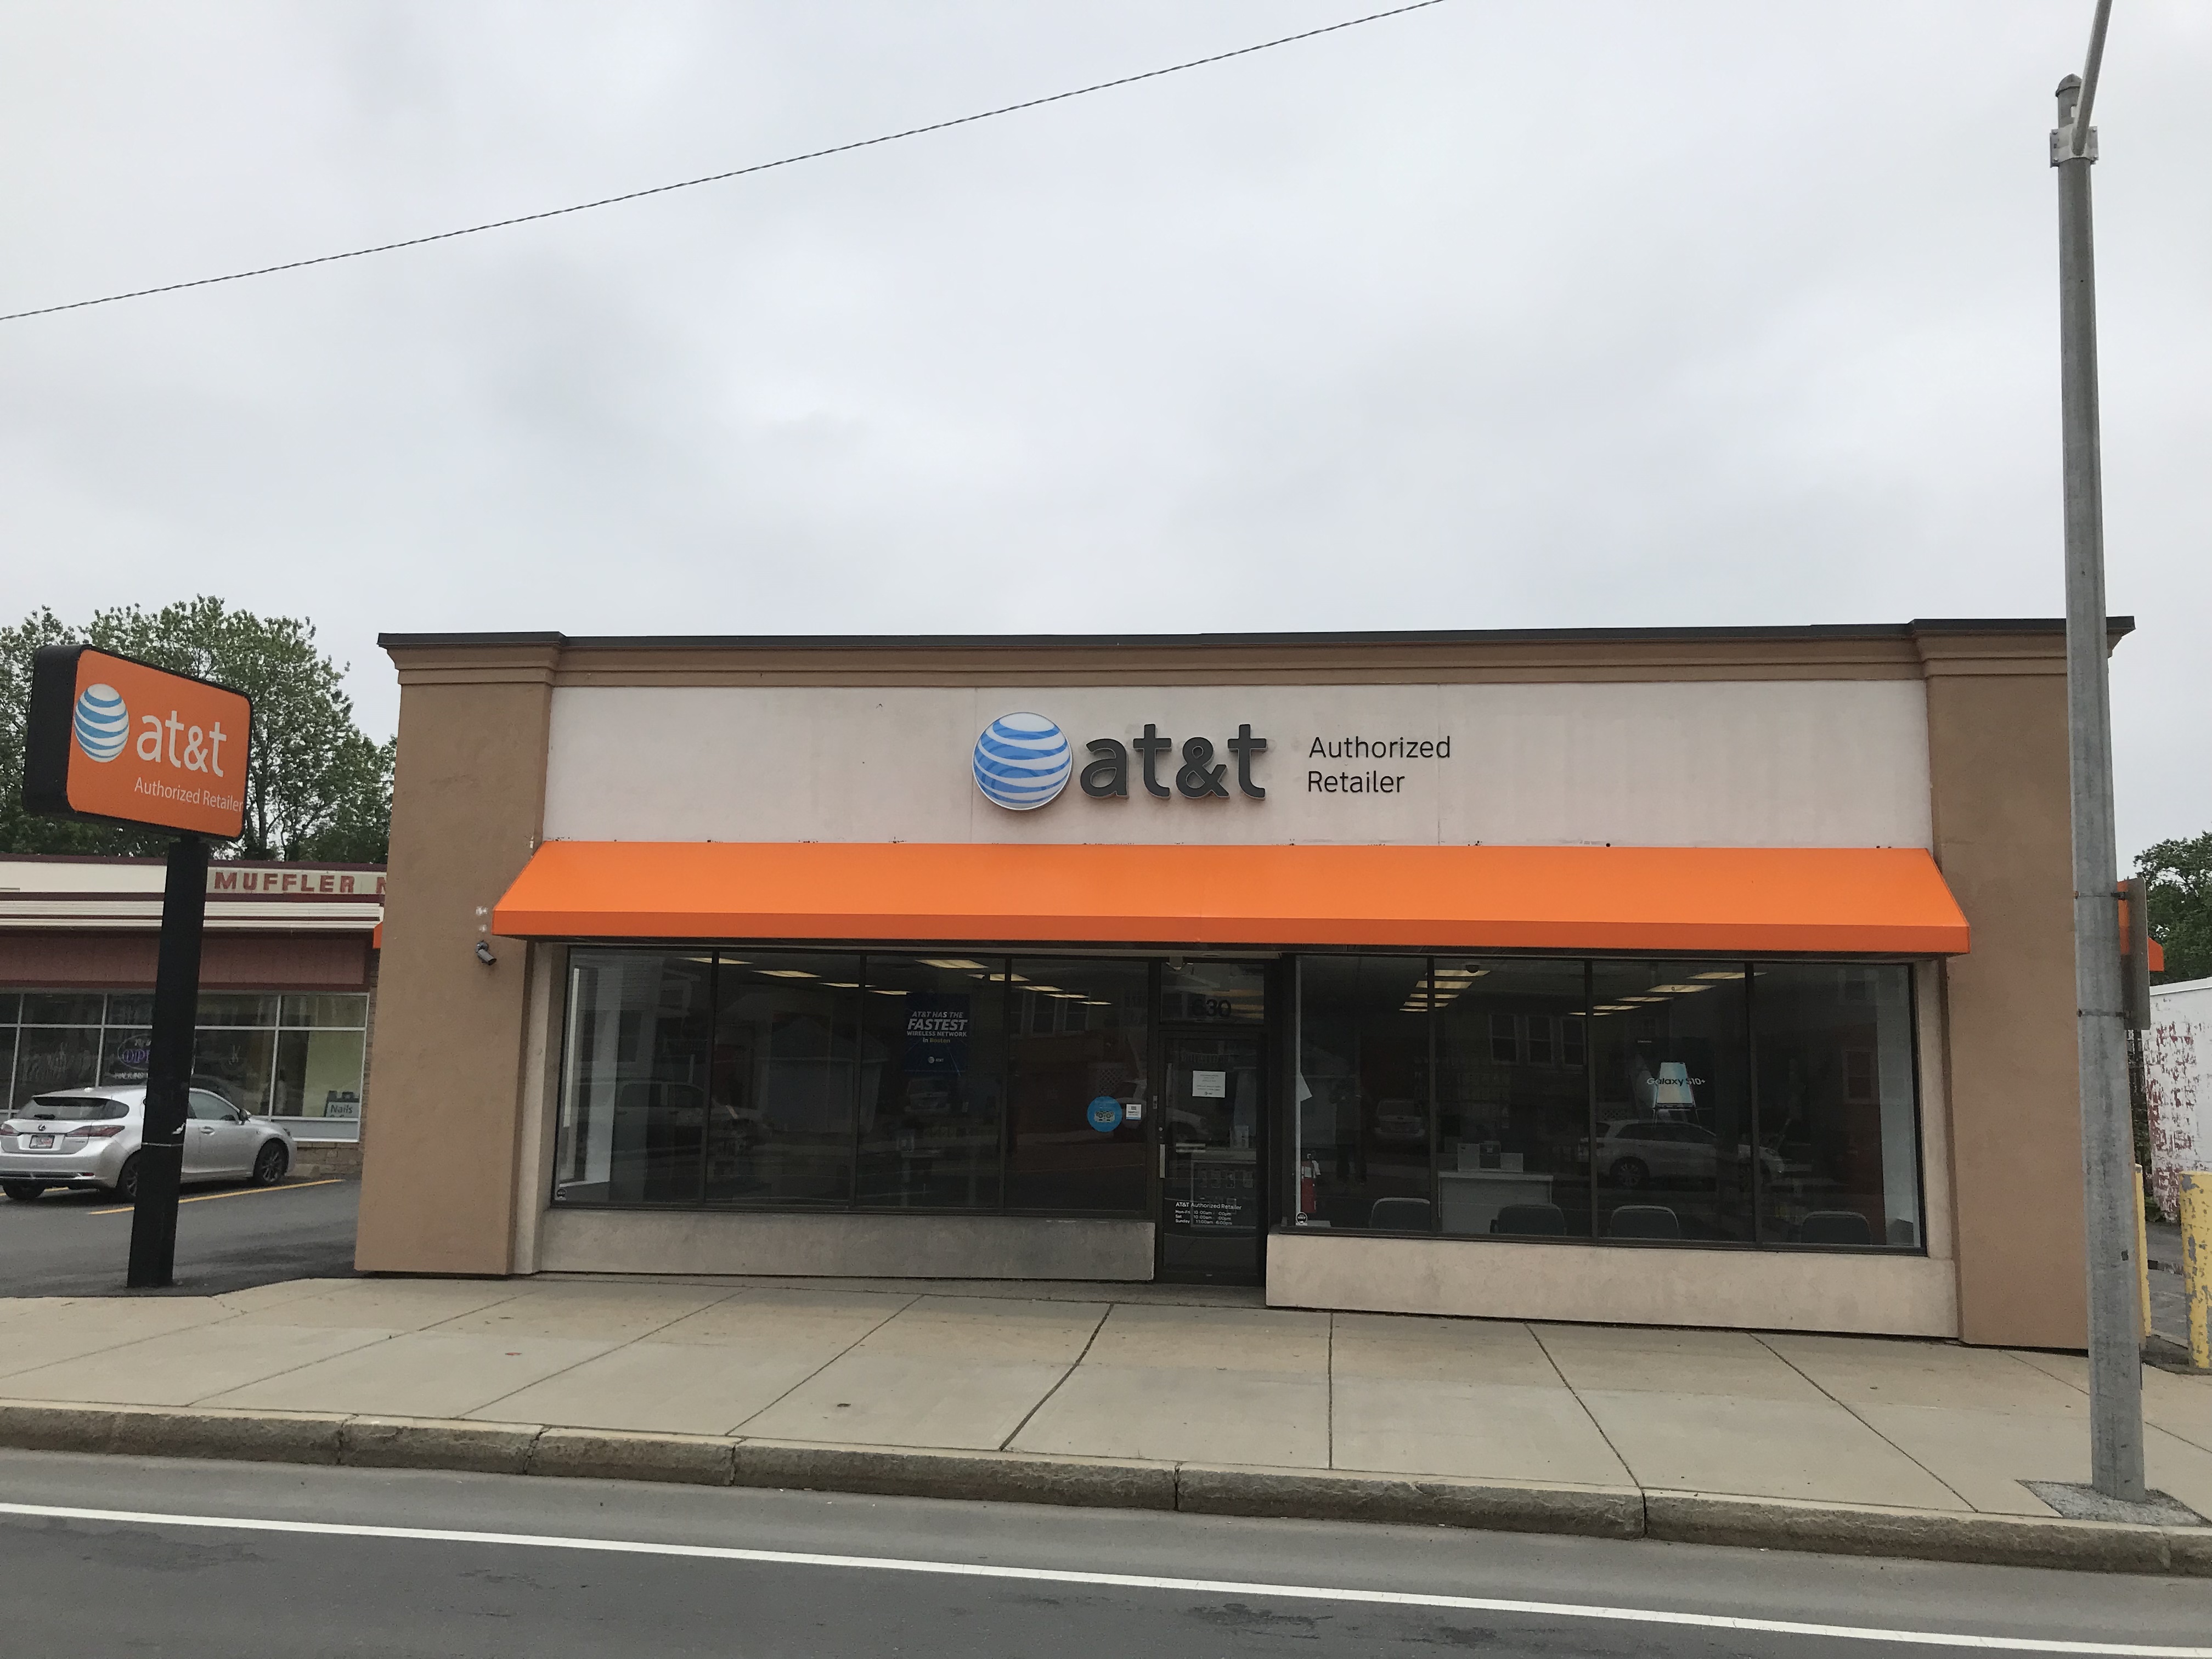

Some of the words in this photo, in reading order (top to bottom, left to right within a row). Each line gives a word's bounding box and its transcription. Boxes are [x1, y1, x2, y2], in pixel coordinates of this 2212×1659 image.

[137, 710, 227, 777] at&t
[1308, 735, 1451, 759] Authorized
[1080, 723, 1268, 799] at&t
[1307, 770, 1405, 793] Retailer
[134, 777, 200, 804] Authorized
[203, 790, 244, 812] Retailer
[214, 872, 356, 894] MUFFLER
[1193, 999, 1232, 1018] 630
[907, 1018, 968, 1031] FASTEST
[1646, 1077, 1684, 1087] Galaxy
[331, 1104, 353, 1114] Nails
